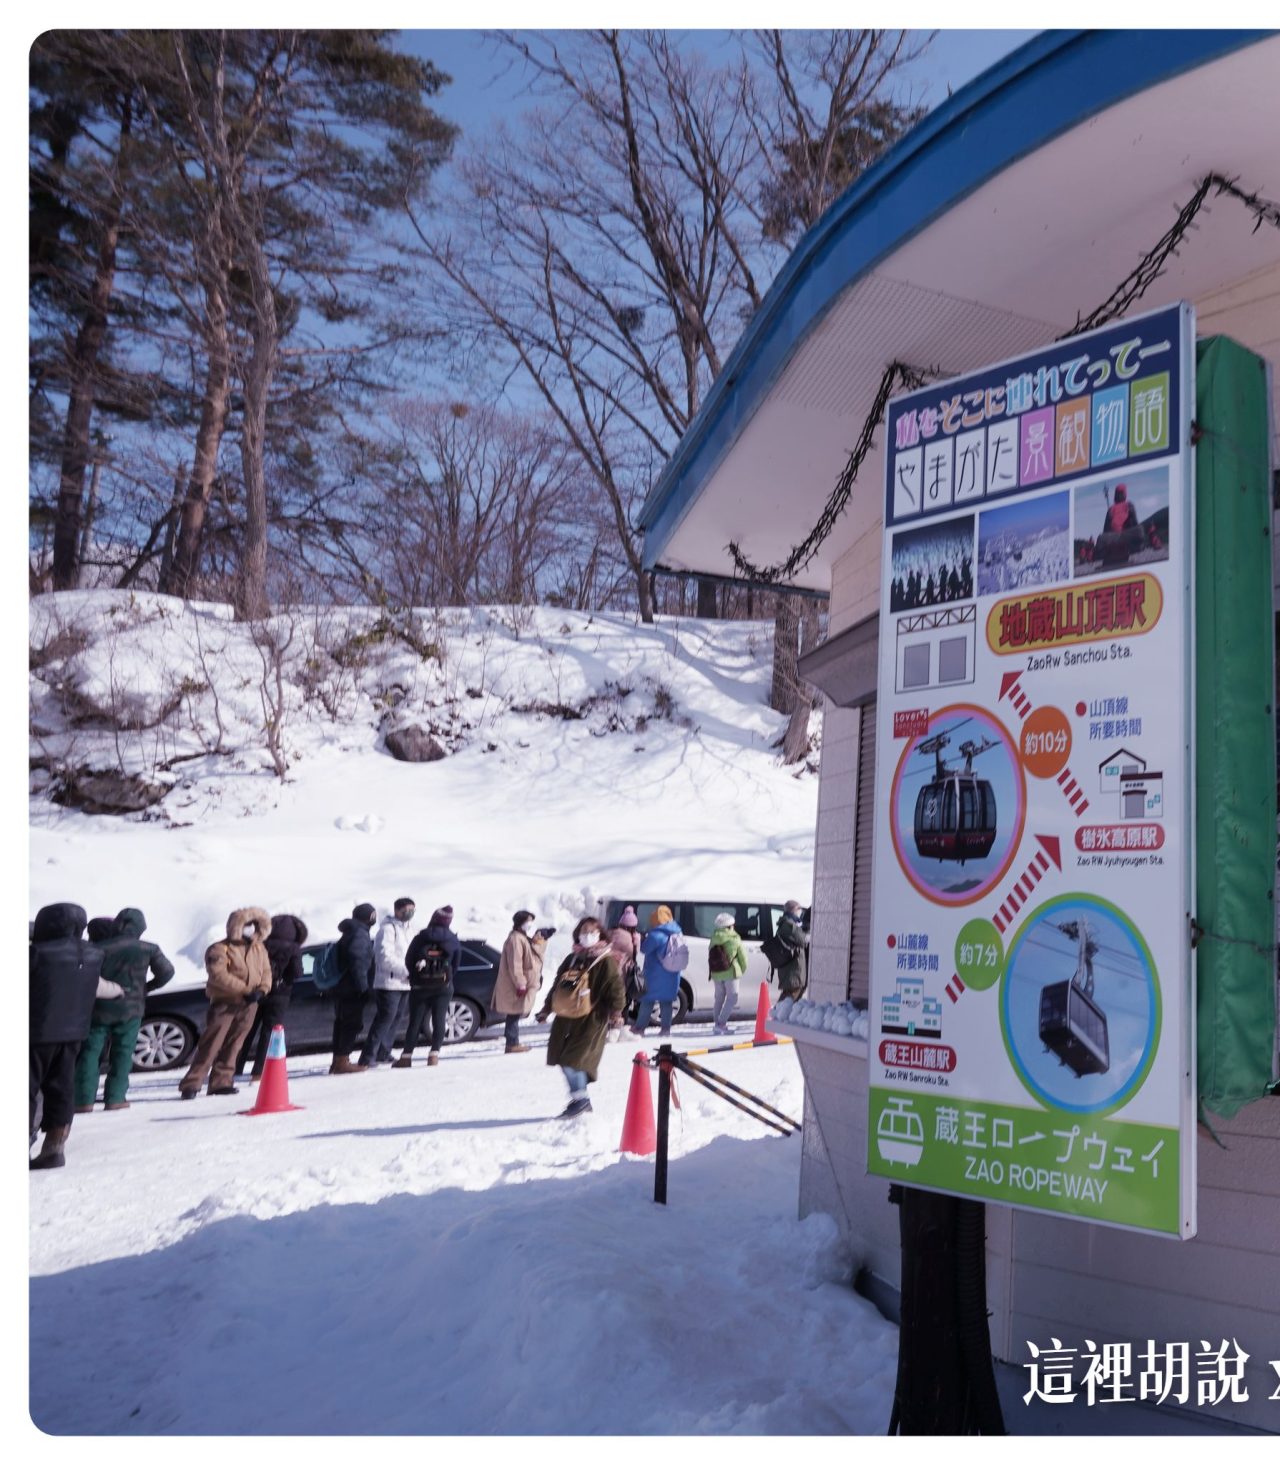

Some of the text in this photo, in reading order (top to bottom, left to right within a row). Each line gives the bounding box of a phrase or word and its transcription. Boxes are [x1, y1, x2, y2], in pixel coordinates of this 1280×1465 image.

[895, 335, 1172, 448] 私をそこに連れてってー
[896, 384, 1166, 506] やまがた景観物語
[999, 580, 1147, 647] 地蔵山頂駅
[1064, 645, 1107, 666] Sanchou
[1110, 642, 1133, 660] Sta.
[1089, 697, 1129, 718] 山頂線
[1089, 718, 1142, 741] 所要時間
[1024, 731, 1069, 756] 約10分
[1081, 826, 1158, 850] 樹氷高原駅
[896, 952, 940, 972] 所要時間
[959, 943, 998, 968] 約7分
[883, 1042, 951, 1070] 蔵王山麓駅
[909, 1073, 937, 1085] Sanroku
[934, 1105, 1165, 1178] 蔵王ロープウェイ
[964, 1156, 1109, 1203] ZAO ROPEWAY
